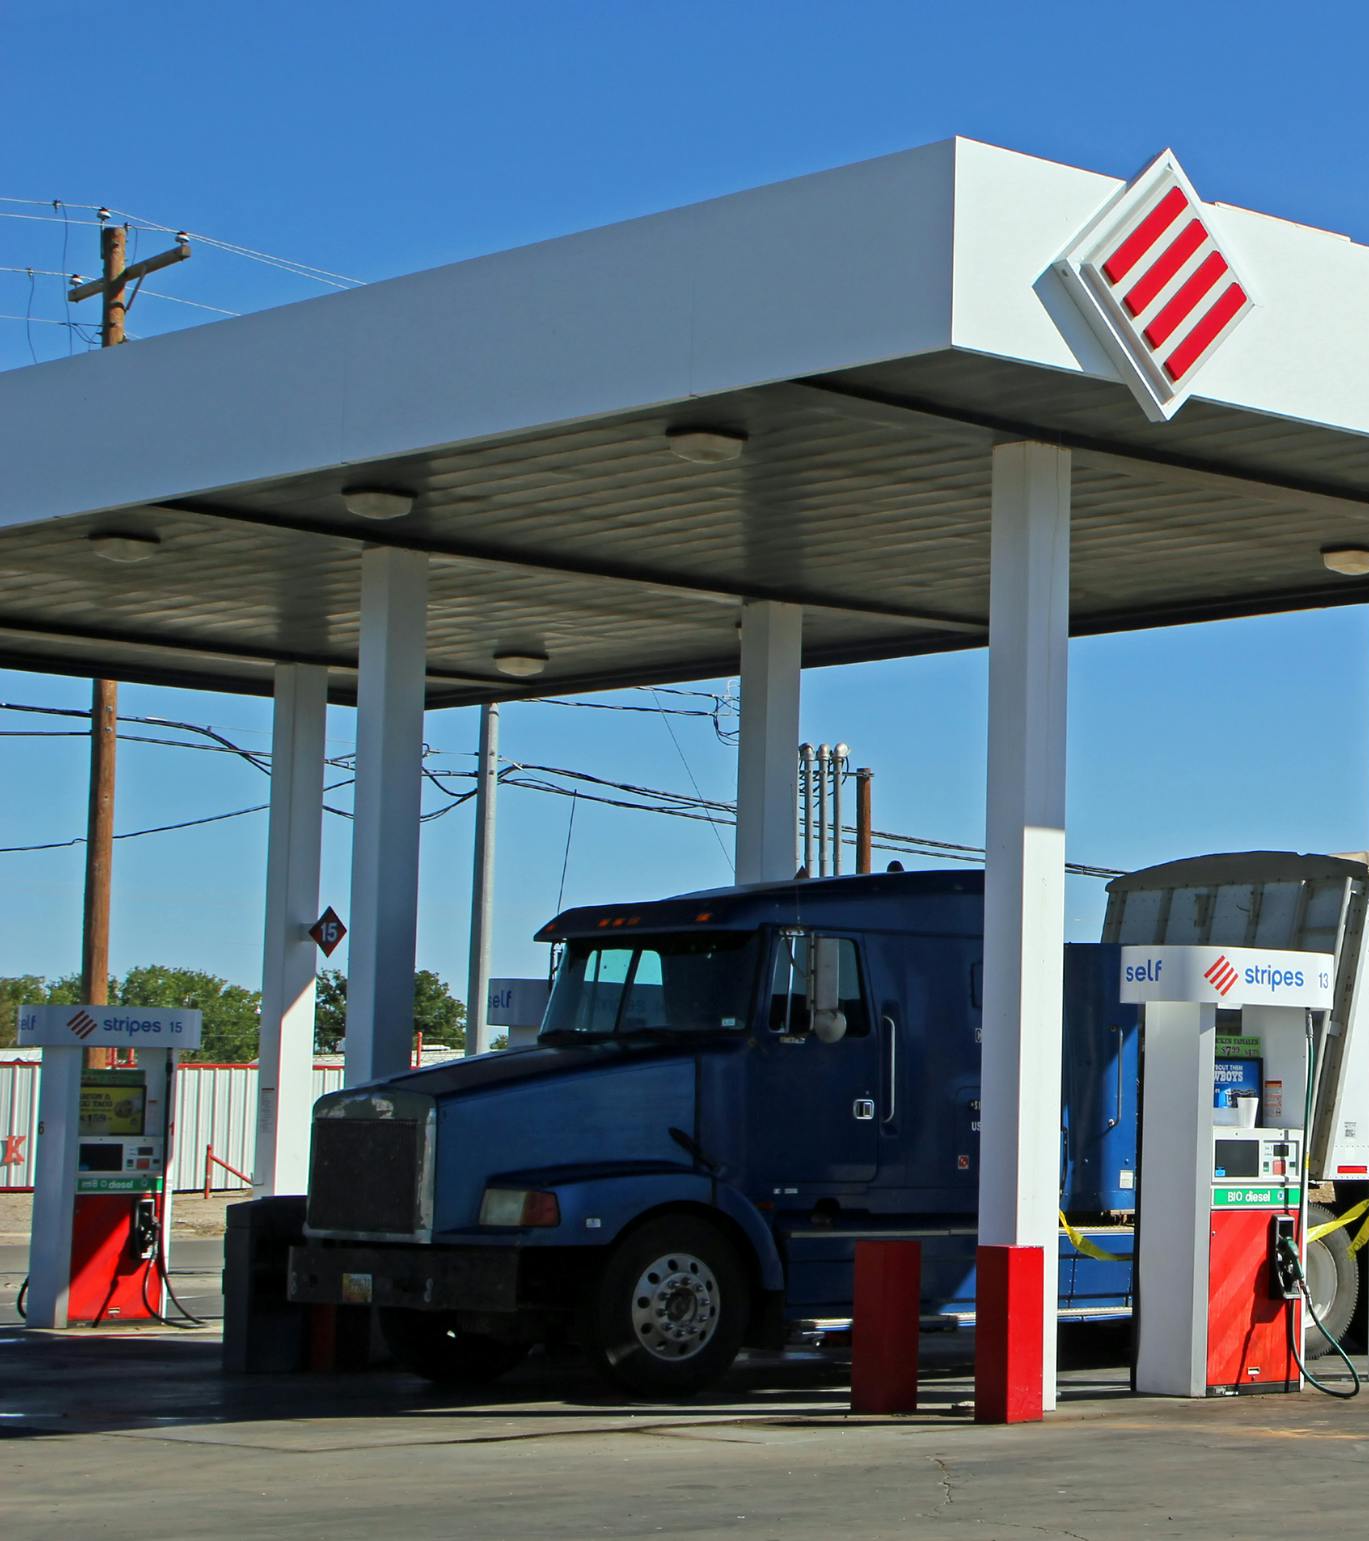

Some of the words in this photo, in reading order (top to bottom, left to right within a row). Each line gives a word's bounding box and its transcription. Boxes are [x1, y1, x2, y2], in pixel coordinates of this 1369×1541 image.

[320, 921, 339, 943] 15
[1125, 959, 1162, 982] self
[1244, 965, 1304, 992] stripes
[1318, 972, 1329, 989] 13
[20, 1015, 37, 1031] elf
[103, 1016, 162, 1037] stripes
[169, 1021, 183, 1034] 15
[1214, 1071, 1244, 1082] WBOYS
[1227, 1191, 1243, 1202] BIO
[1245, 1189, 1271, 1203] diesel
